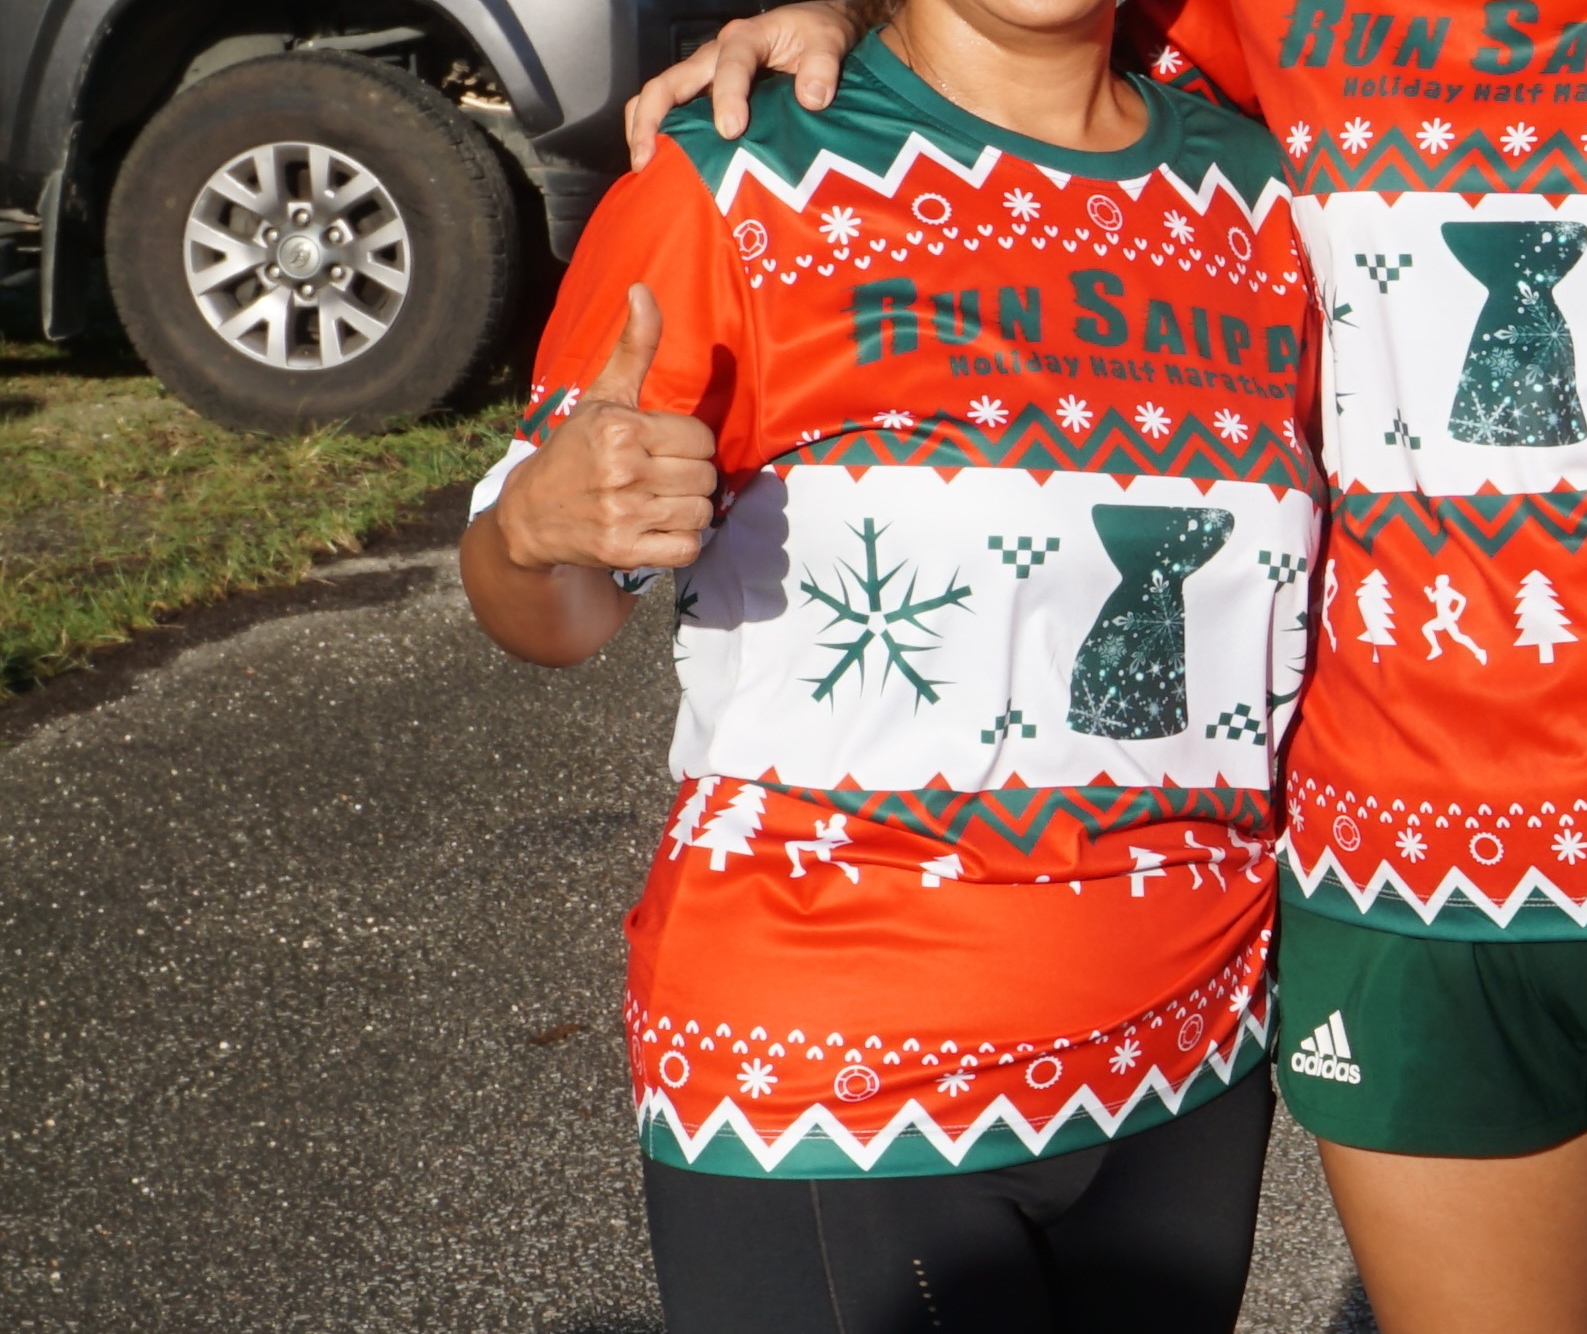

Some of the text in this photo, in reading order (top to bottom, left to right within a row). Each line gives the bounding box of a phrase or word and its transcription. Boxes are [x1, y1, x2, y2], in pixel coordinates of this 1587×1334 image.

[1343, 76, 1464, 103] Holiday
[1473, 81, 1544, 104] Half
[842, 269, 1301, 373] RUN SAIPA
[947, 352, 1080, 380] Holiday
[1087, 355, 1157, 385] Half
[1291, 1051, 1361, 1085] adidas
